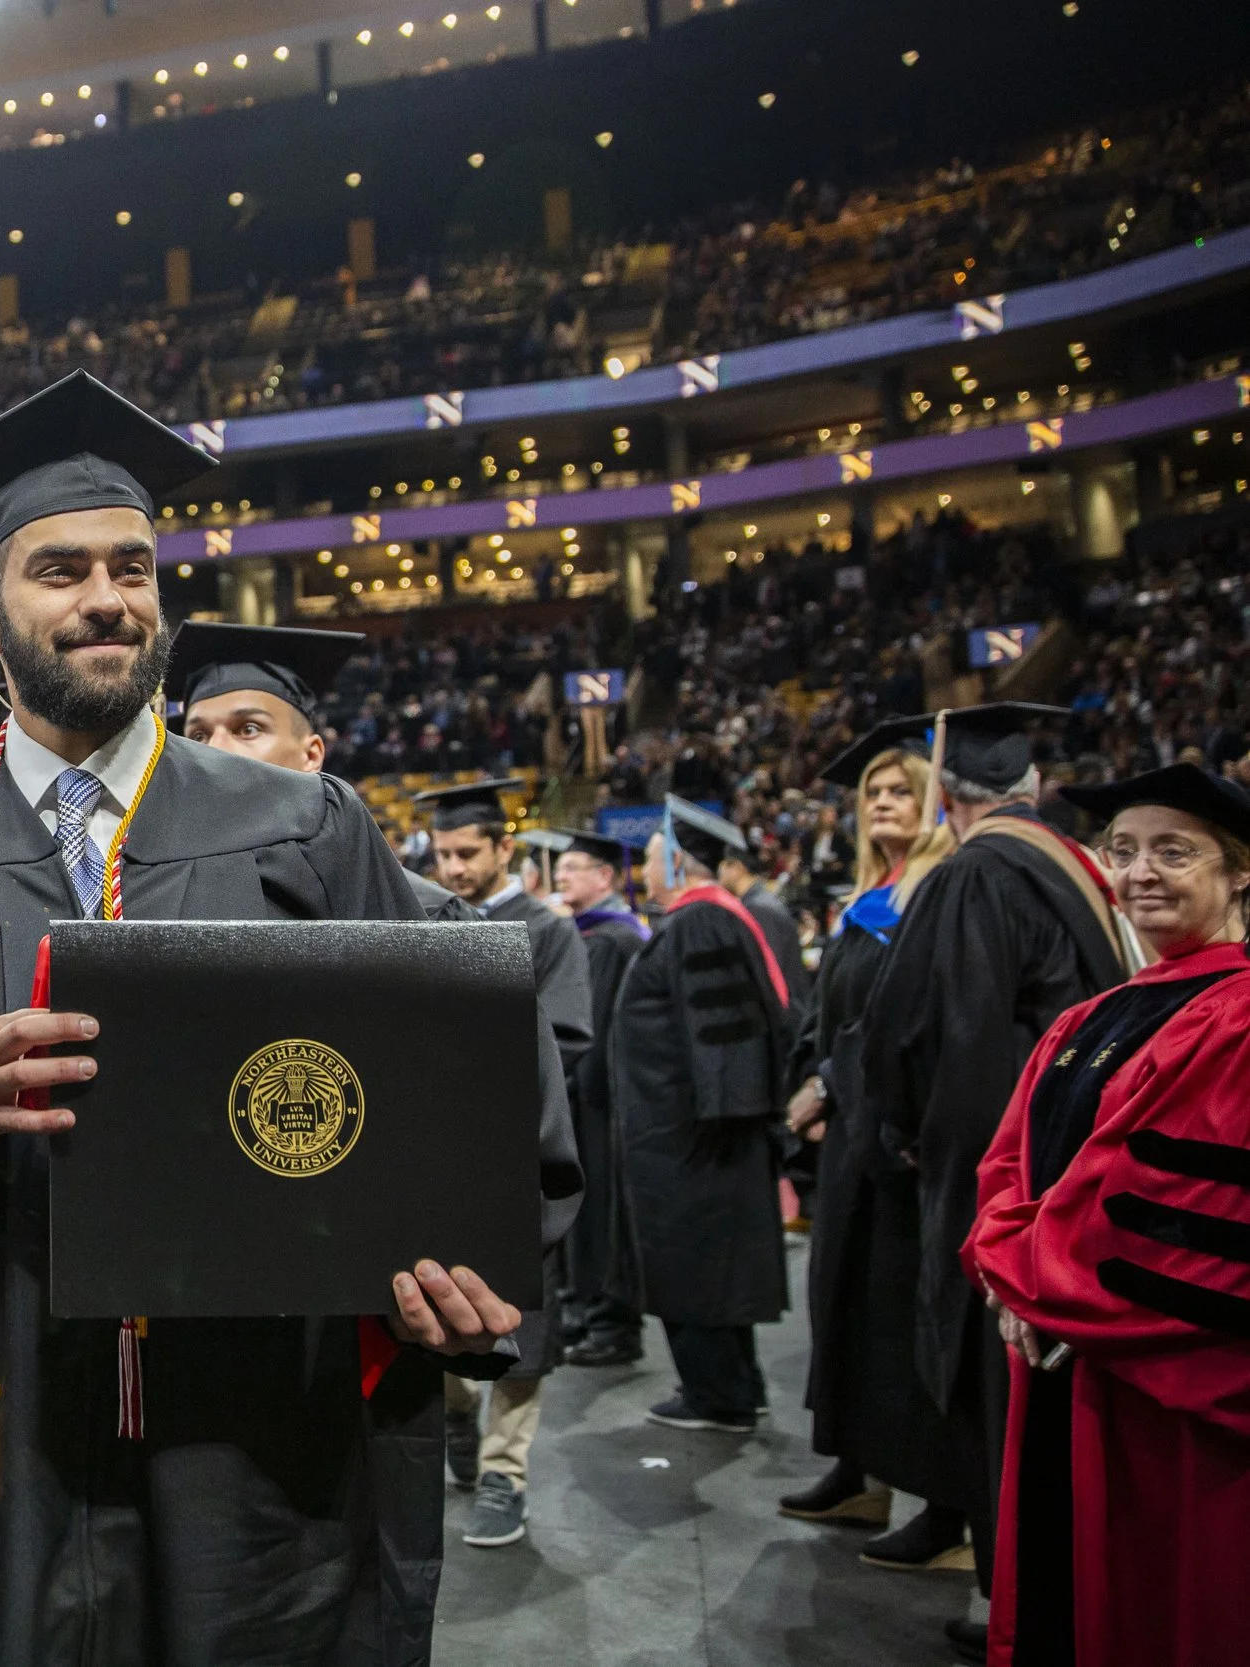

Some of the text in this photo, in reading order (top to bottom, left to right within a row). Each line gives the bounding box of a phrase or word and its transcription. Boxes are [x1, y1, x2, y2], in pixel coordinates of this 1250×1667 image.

[956, 294, 1005, 341] N
[678, 355, 720, 397] N
[424, 391, 463, 430] N
[189, 420, 227, 453] N
[1025, 418, 1064, 453] N
[839, 451, 874, 484] N
[670, 480, 702, 512] N
[506, 499, 537, 528] N
[985, 628, 1023, 662] N
[578, 673, 611, 703] N
[241, 1046, 351, 1087] NORTHEASTERN
[281, 1113, 313, 1121] VERITAS
[253, 1139, 342, 1169] UNIVERSITY
